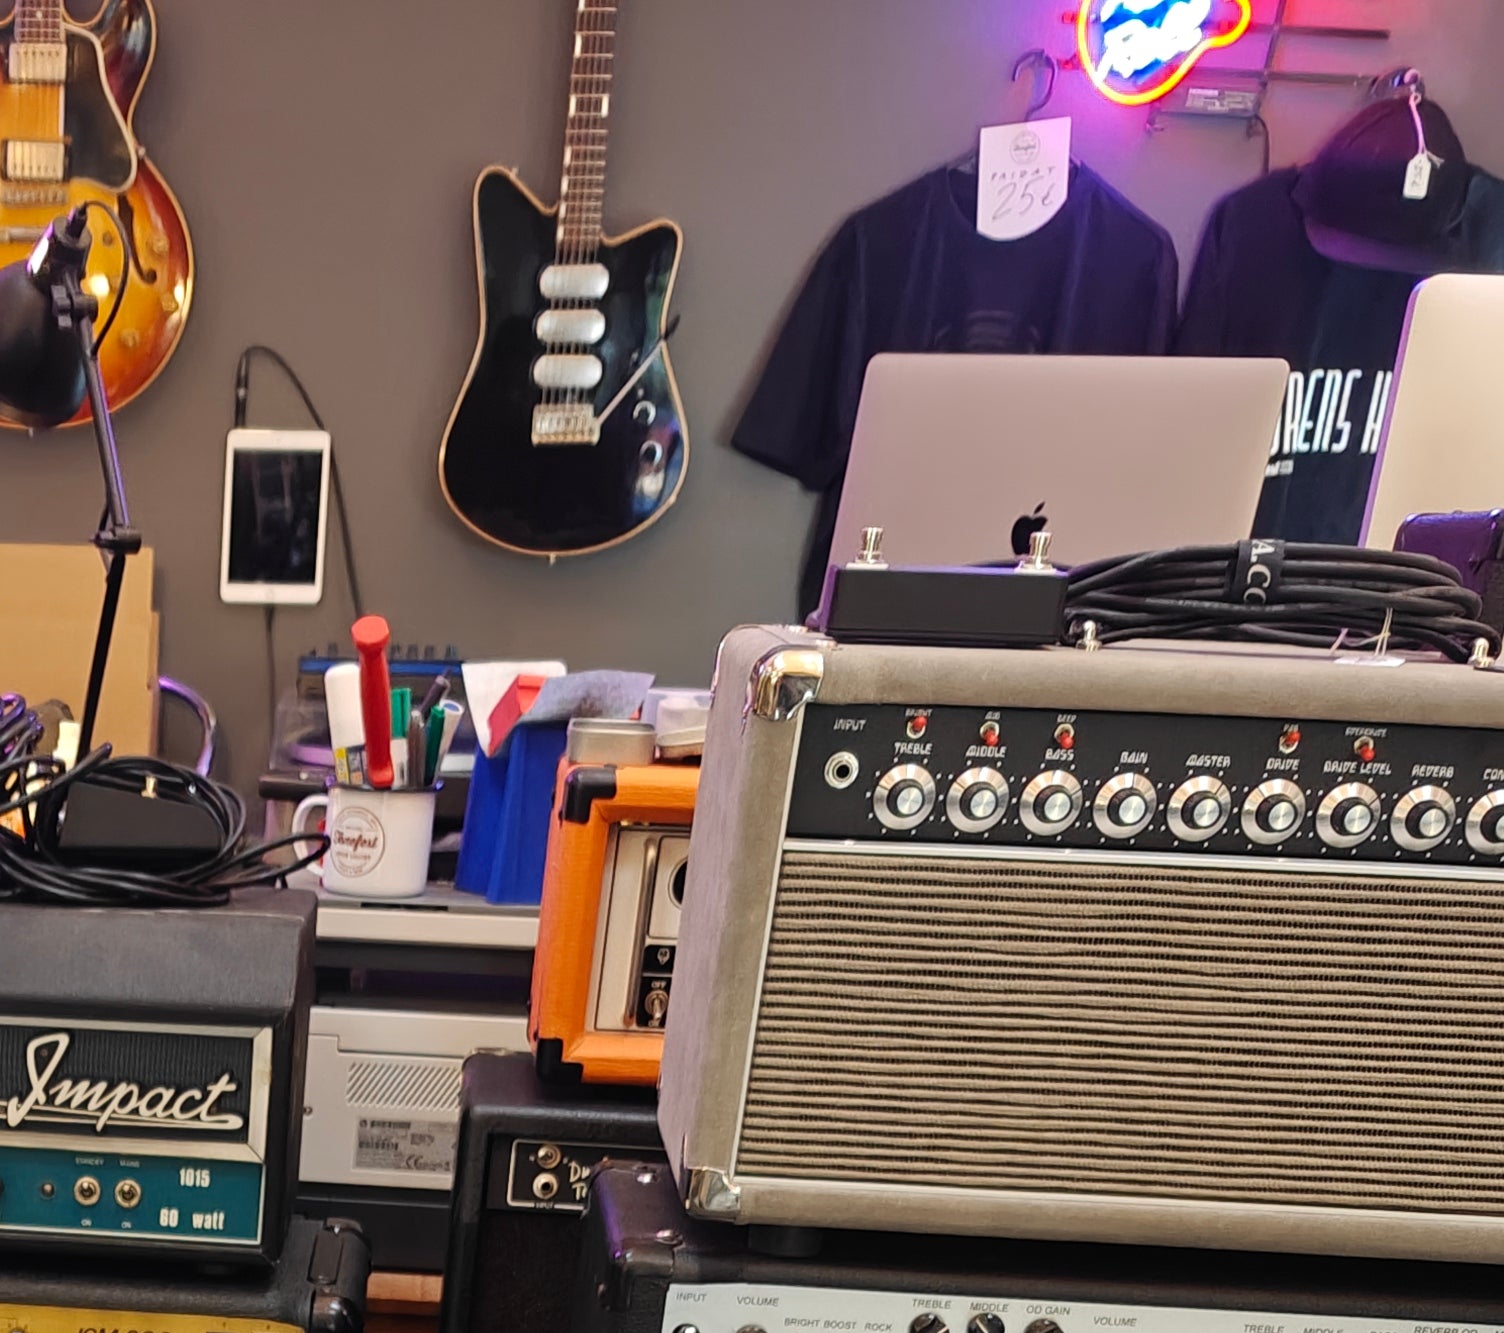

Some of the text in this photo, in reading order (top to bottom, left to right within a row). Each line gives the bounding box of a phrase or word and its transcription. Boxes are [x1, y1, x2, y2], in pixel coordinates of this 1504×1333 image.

[833, 718, 867, 732] INPUT
[894, 742, 933, 755] TREBLE
[965, 745, 1007, 758] MIDDLE
[1045, 748, 1075, 761] BASS
[1120, 751, 1149, 765] GAIN
[1185, 754, 1231, 768] MASTER
[1266, 757, 1300, 771] DRIVE
[1323, 760, 1392, 776] DRIVE LEVEL
[1411, 764, 1455, 779] REVERB
[179, 1168, 210, 1188] 1015
[159, 1208, 225, 1231] 60 watt
[676, 1292, 707, 1302] INPUT
[737, 1296, 780, 1307] VOLUME
[912, 1298, 952, 1310] TREBLE
[969, 1302, 1009, 1313] MIDDLE
[1026, 1305, 1071, 1316] OD GAIN
[784, 1317, 820, 1328] BRIGHT
[823, 1319, 857, 1330] BOOST
[864, 1322, 893, 1332] ROCK
[1093, 1316, 1138, 1327] VOLUME
